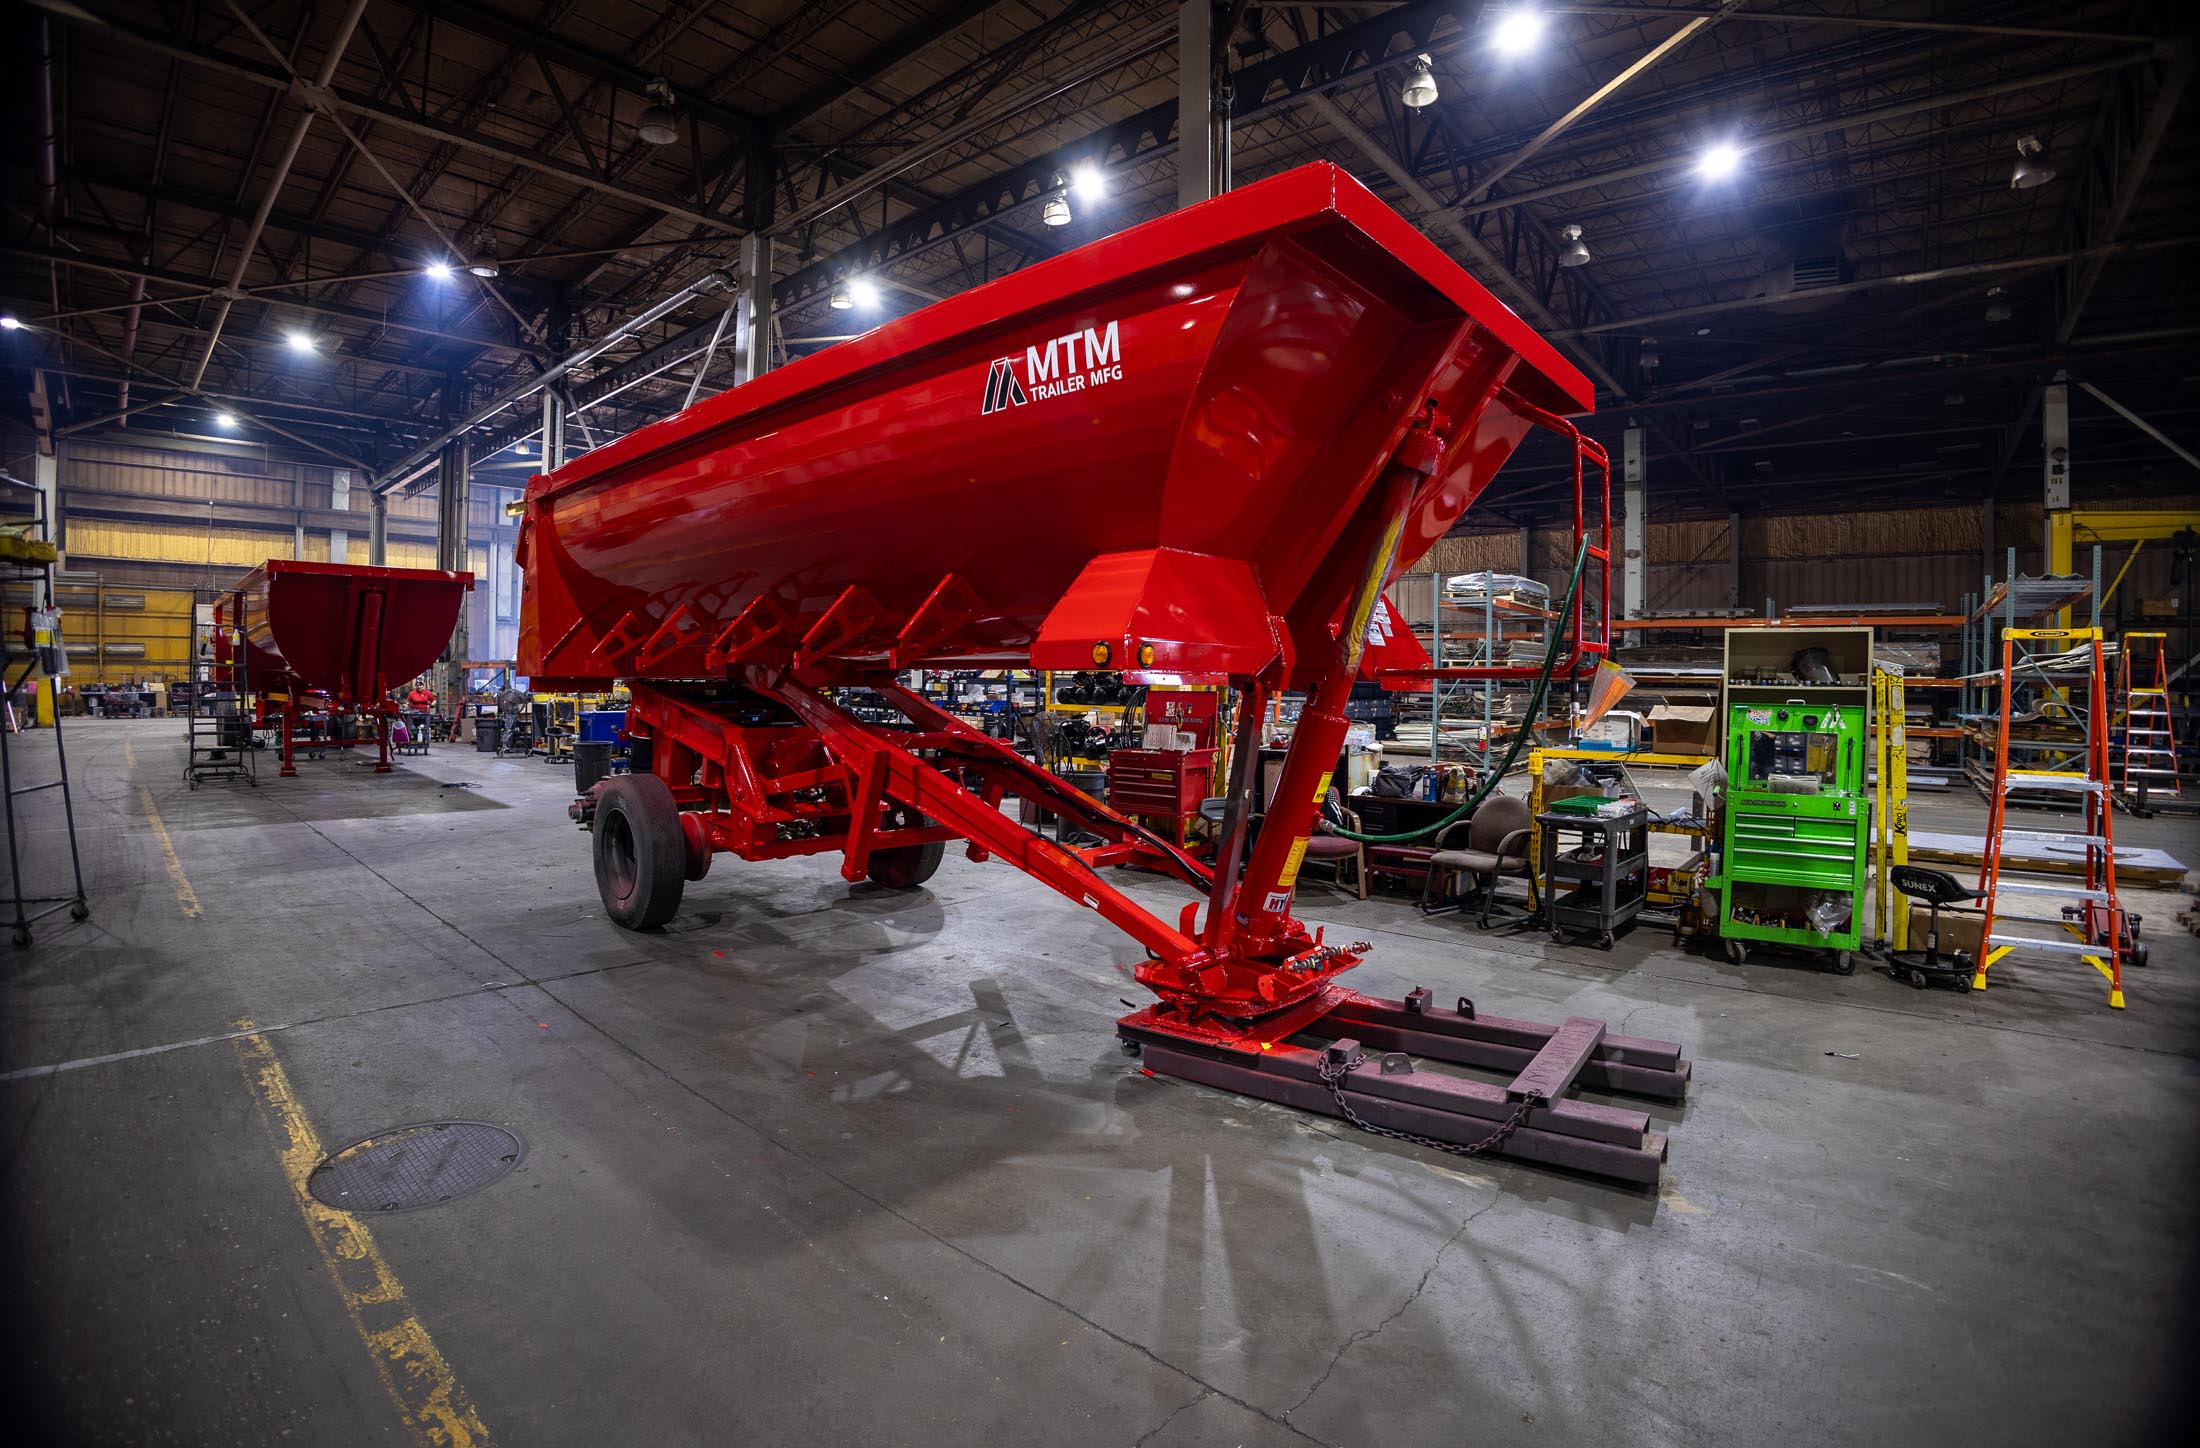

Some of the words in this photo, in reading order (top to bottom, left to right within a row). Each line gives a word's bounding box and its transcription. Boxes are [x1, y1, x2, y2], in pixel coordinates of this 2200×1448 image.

[1026, 320, 1121, 385] MTM
[1029, 375, 1086, 402] TRAILER
[1090, 364, 1123, 387] MFG
[1901, 878, 1937, 893] SUNEX
